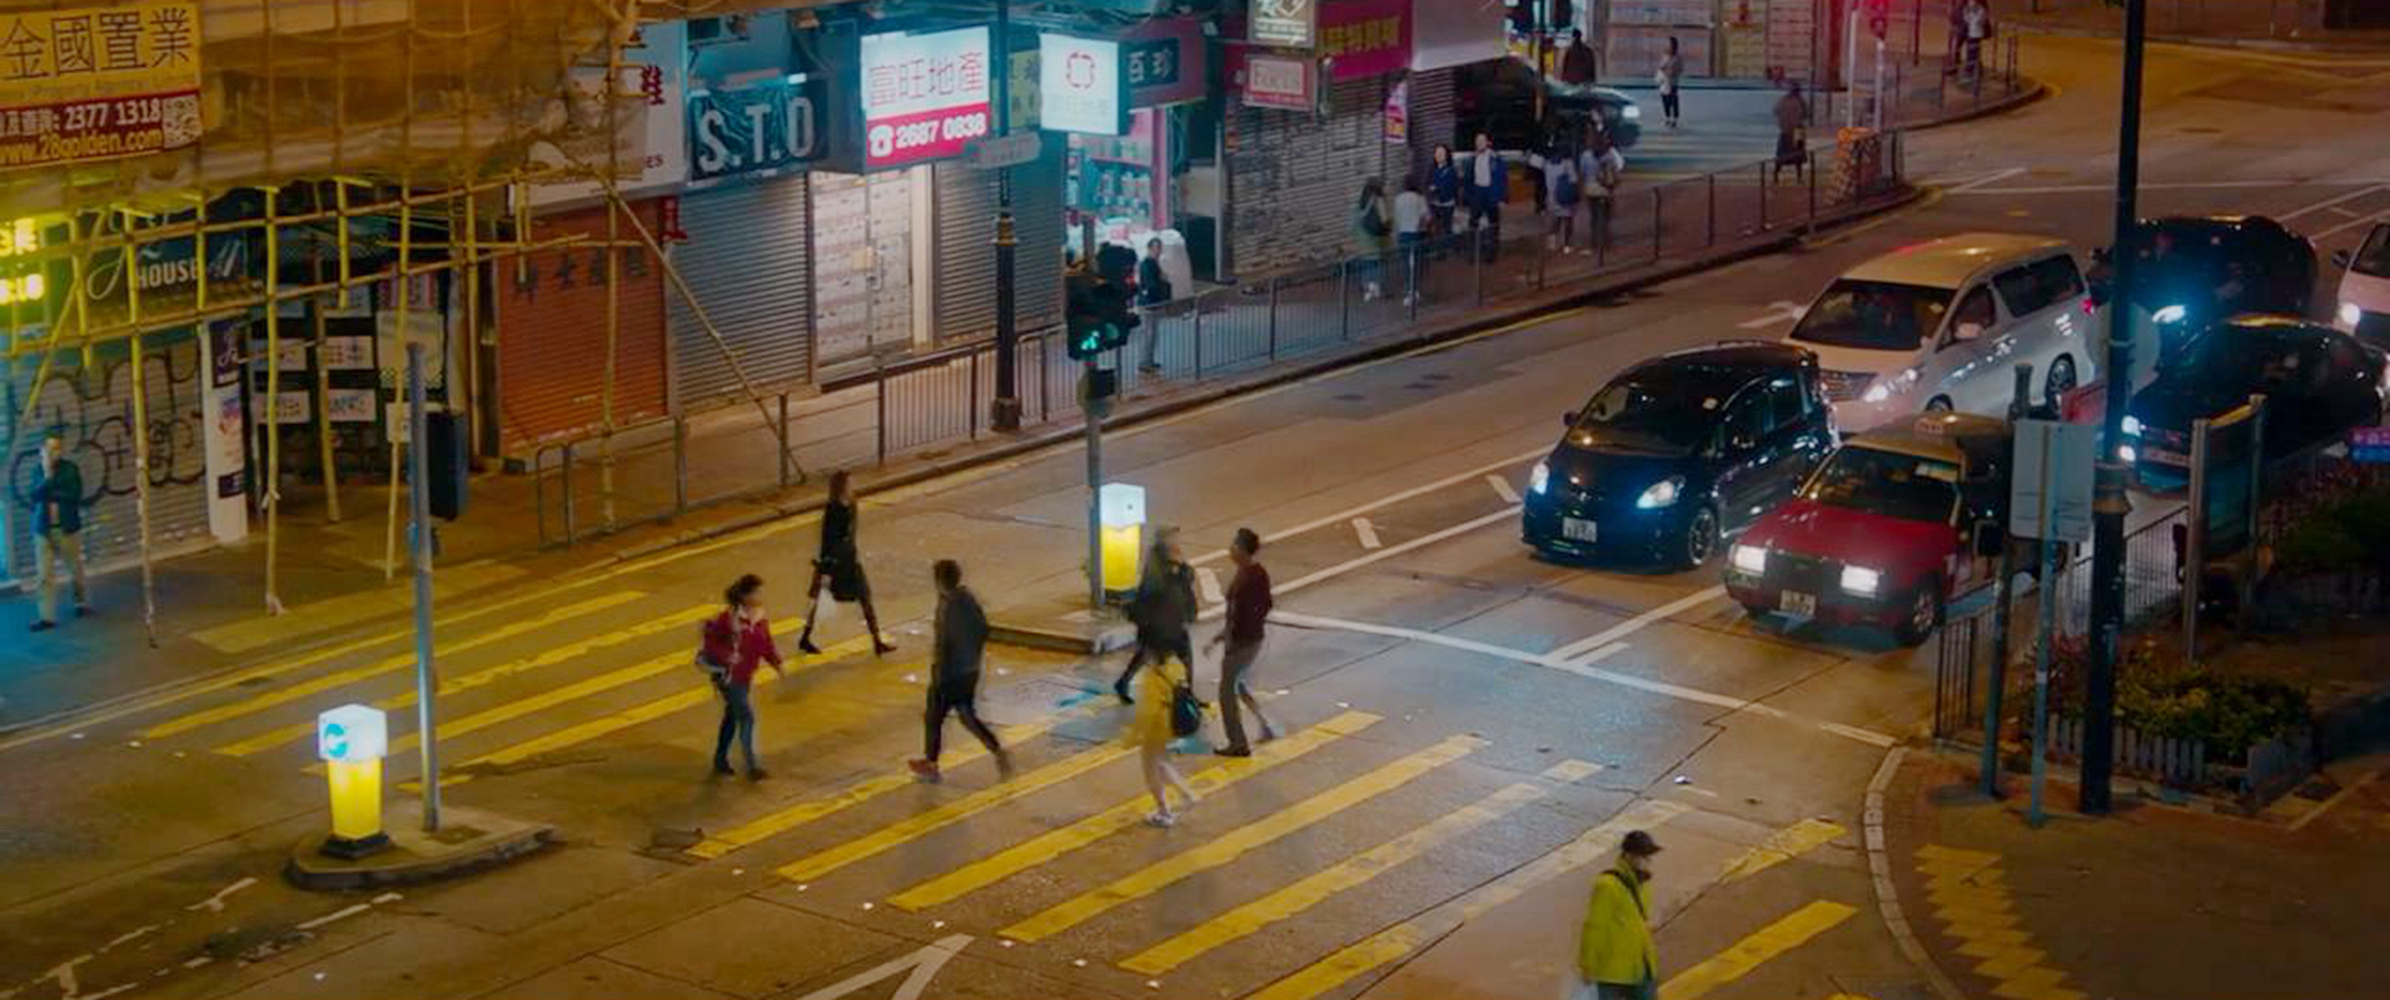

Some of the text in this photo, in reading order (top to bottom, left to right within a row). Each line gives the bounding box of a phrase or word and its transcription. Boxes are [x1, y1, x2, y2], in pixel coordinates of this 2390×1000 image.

[0, 7, 192, 81] 金國置業
[868, 51, 985, 107] 富旺地產
[64, 103, 109, 130] 2377
[115, 98, 162, 125] 1318
